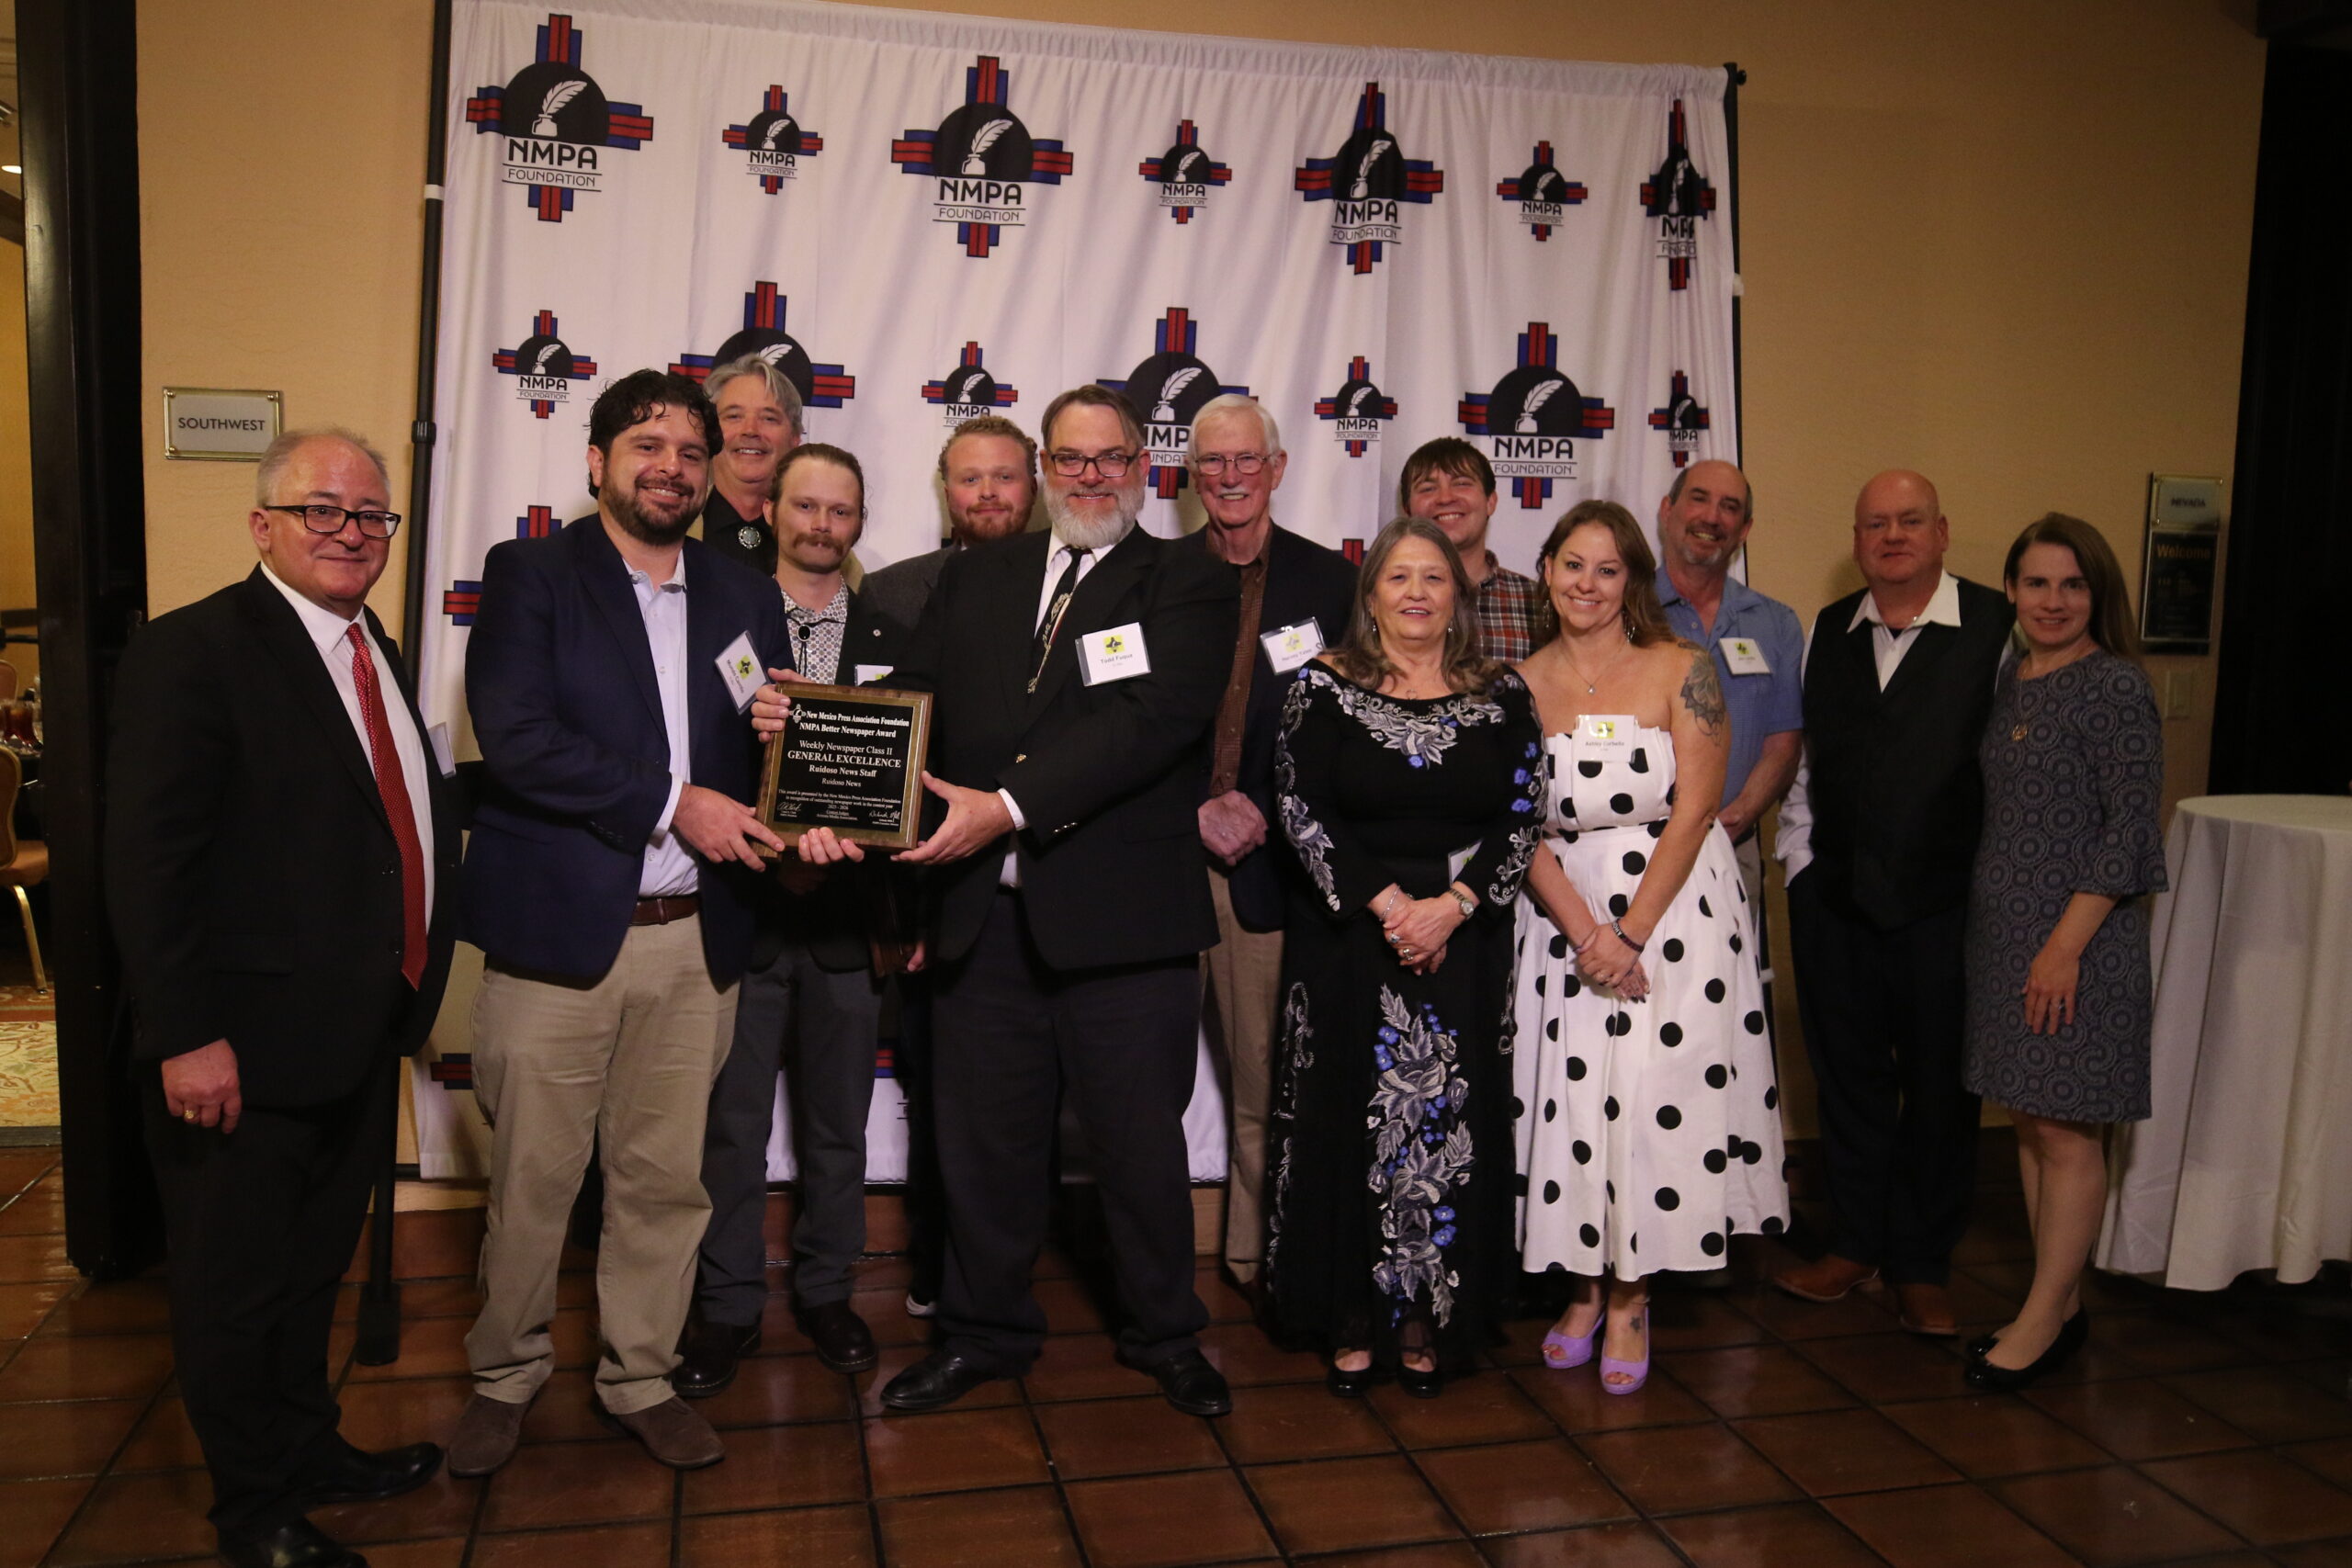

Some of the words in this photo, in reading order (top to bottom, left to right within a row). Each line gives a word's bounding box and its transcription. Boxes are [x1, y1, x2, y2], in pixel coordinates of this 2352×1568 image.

[508, 138, 597, 170] NMPA
[750, 151, 795, 166] NMPA
[508, 168, 595, 186] FOUNDATION
[750, 166, 795, 176] FOUNDATION
[939, 178, 1022, 205] NMPA
[1162, 184, 1205, 197] NMPA
[939, 208, 1019, 221] FOUNDATION
[1334, 199, 1397, 224] NMPA
[1522, 201, 1562, 215] NMPA
[1333, 227, 1396, 241] FOUNDATION
[520, 376, 568, 390] NMPA
[520, 391, 567, 400] FOUNDATION
[946, 404, 990, 417] NMPA
[178, 417, 266, 432] SOUTHWEST
[1337, 419, 1378, 431] NMPA
[1494, 437, 1573, 459] NMPA
[1494, 463, 1572, 475] FOUNDATION
[819, 711, 837, 720] Mexico
[838, 713, 851, 722] Press
[852, 714, 879, 724] Association
[880, 716, 910, 727] Foundation
[799, 722, 820, 731] NMPA
[821, 724, 840, 733] Better
[841, 726, 875, 737] Newspaper
[876, 729, 897, 738] Award
[799, 739, 825, 750] Weekly
[826, 742, 865, 753] Newspaper
[865, 746, 885, 755] Class
[887, 747, 893, 755] II
[787, 750, 834, 762] GENERAL
[836, 754, 901, 768] EXCELLENCE
[808, 764, 838, 774] Ruidoso
[840, 767, 858, 776] News
[859, 769, 877, 778] Staff
[821, 778, 844, 786] Ruidoso
[845, 779, 862, 787] News
